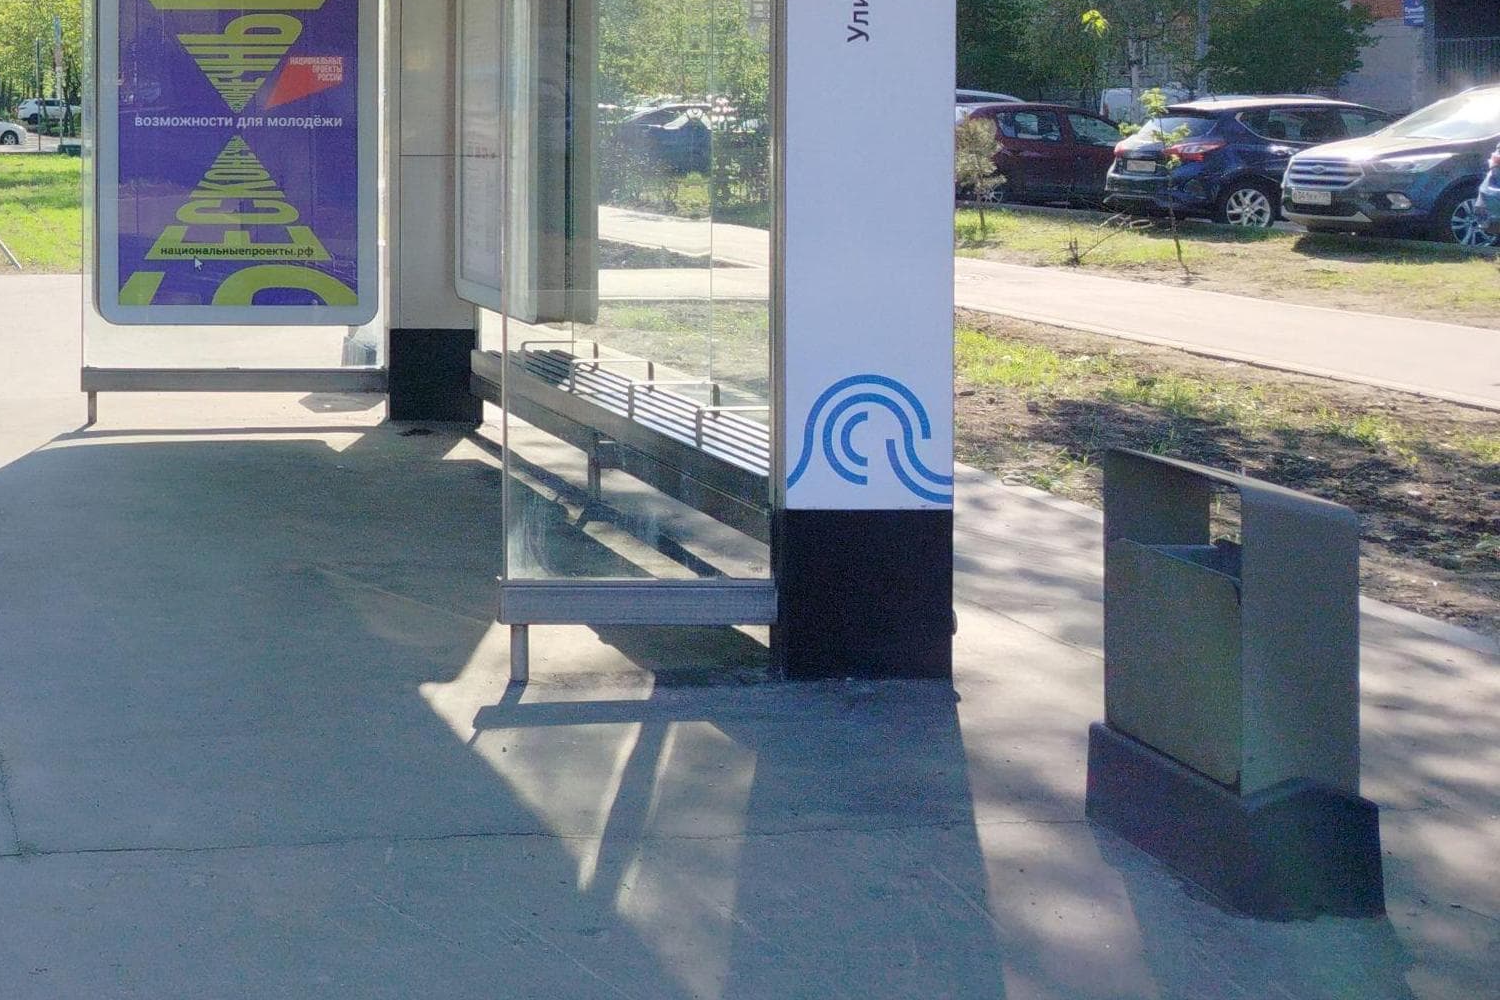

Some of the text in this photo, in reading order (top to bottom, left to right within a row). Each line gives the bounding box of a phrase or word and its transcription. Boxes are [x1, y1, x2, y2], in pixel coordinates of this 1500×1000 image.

[134, 114, 343, 129] возможности для молодёжи
[160, 246, 314, 258] национальныепроекты.рф
